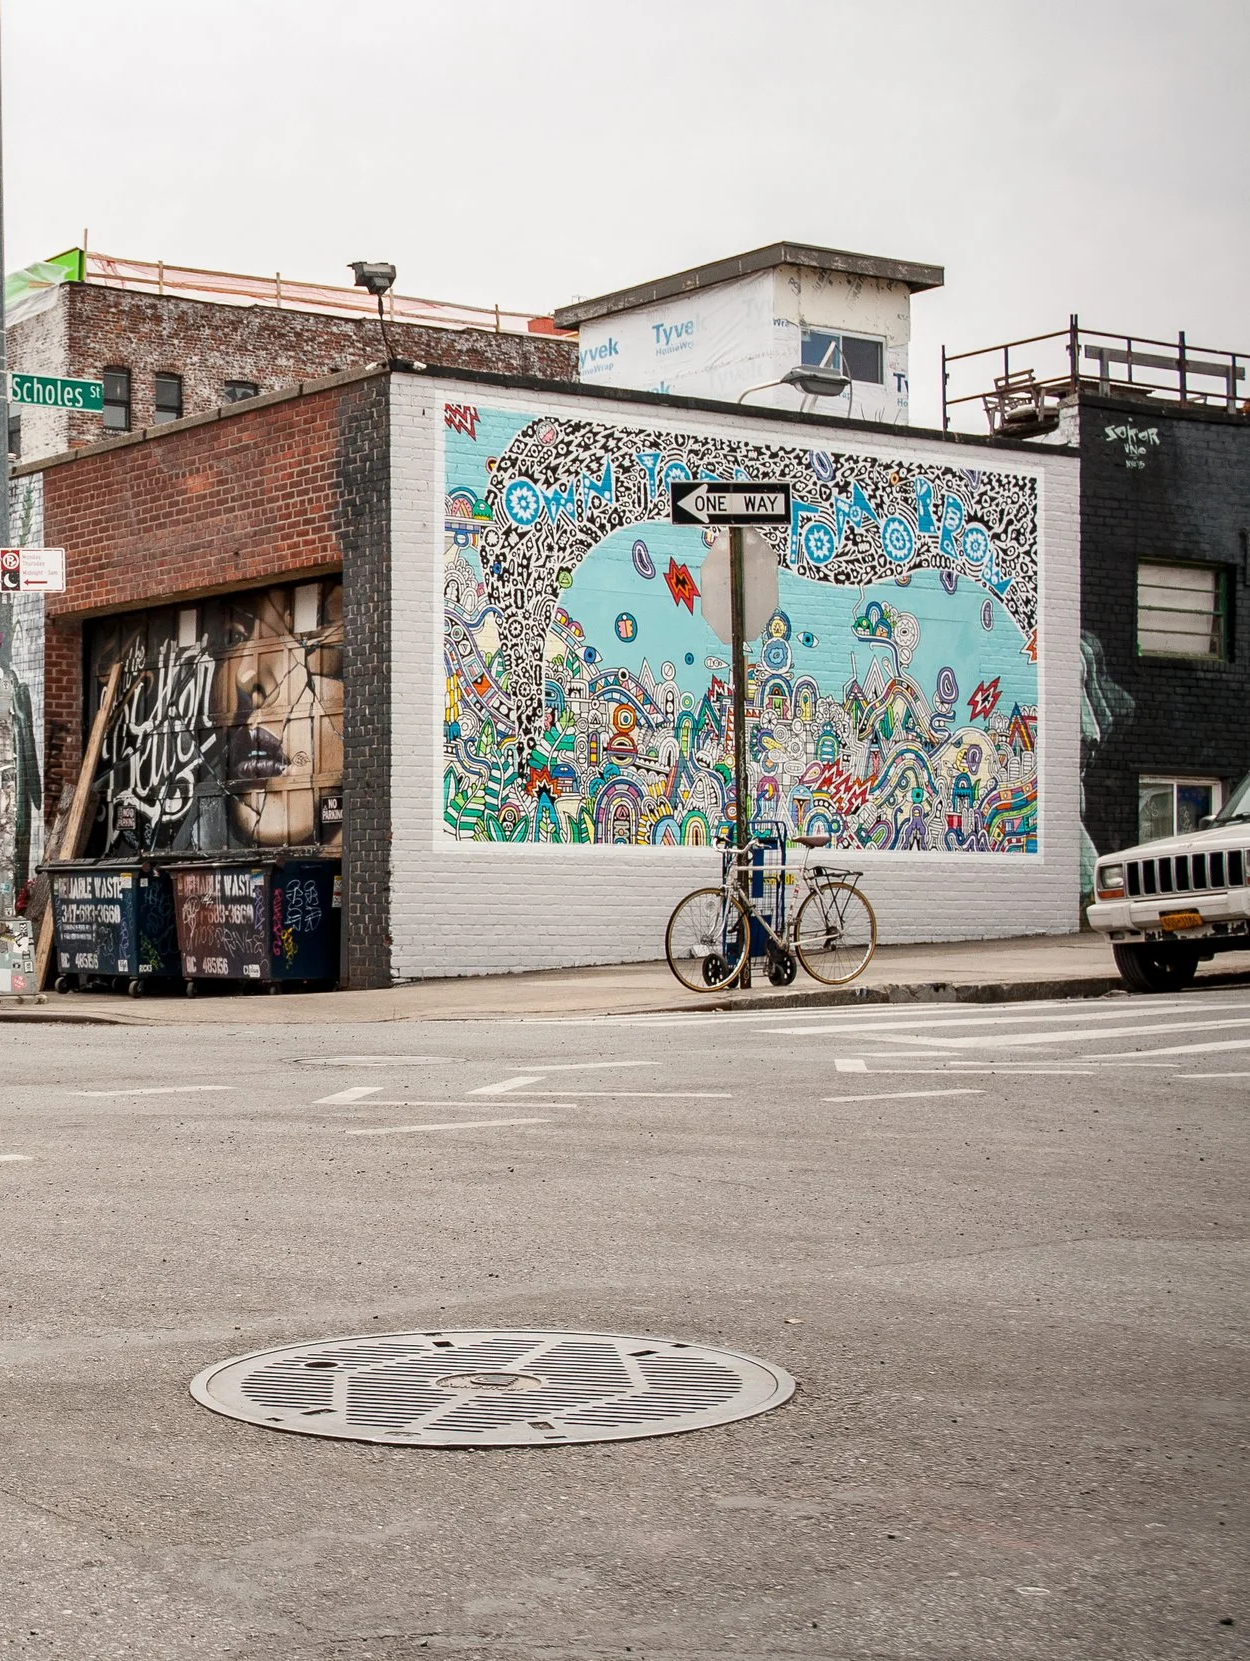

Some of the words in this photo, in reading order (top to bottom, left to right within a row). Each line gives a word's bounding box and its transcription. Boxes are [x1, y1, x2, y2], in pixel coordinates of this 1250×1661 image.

[580, 337, 620, 369] yvek
[12, 377, 84, 408] Scholes
[90, 385, 101, 399] St
[694, 495, 727, 512] ONE
[743, 495, 779, 512] WAY
[328, 798, 338, 809] NO
[58, 876, 92, 899] RELIABLE
[93, 876, 123, 899] WASTE
[223, 874, 256, 898] WASTE
